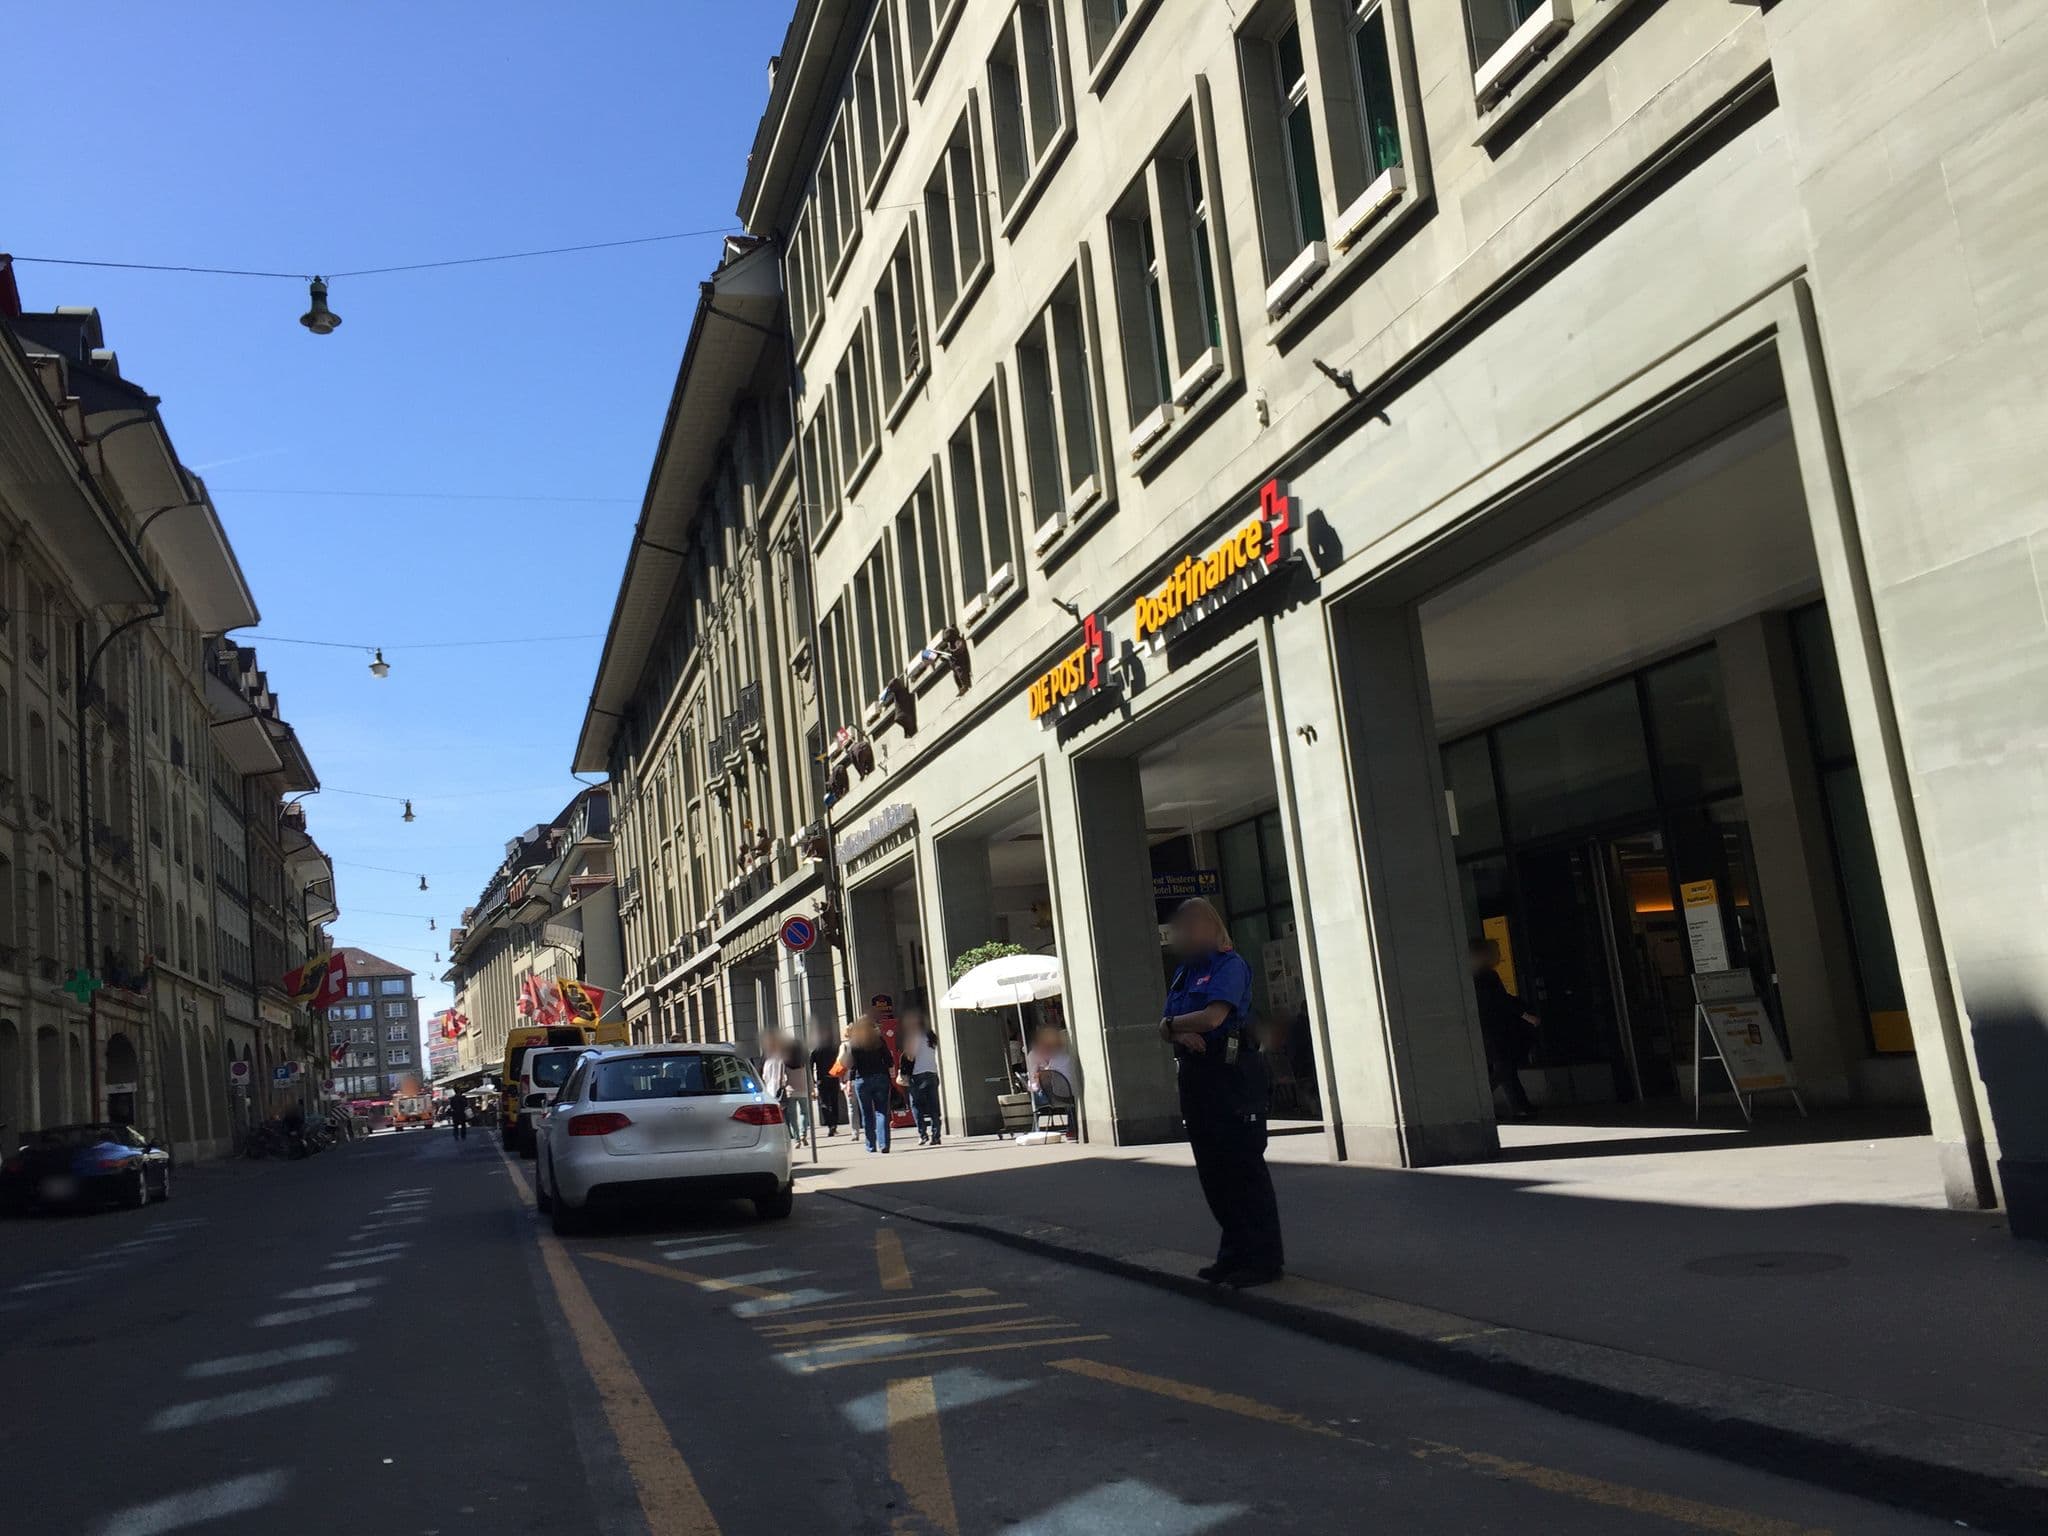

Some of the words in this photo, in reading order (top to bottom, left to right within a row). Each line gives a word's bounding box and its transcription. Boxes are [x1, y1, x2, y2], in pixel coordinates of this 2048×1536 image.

[1135, 519, 1264, 641] PostFinance
[1028, 675, 1051, 721] DIE
[1050, 645, 1088, 706] POST
